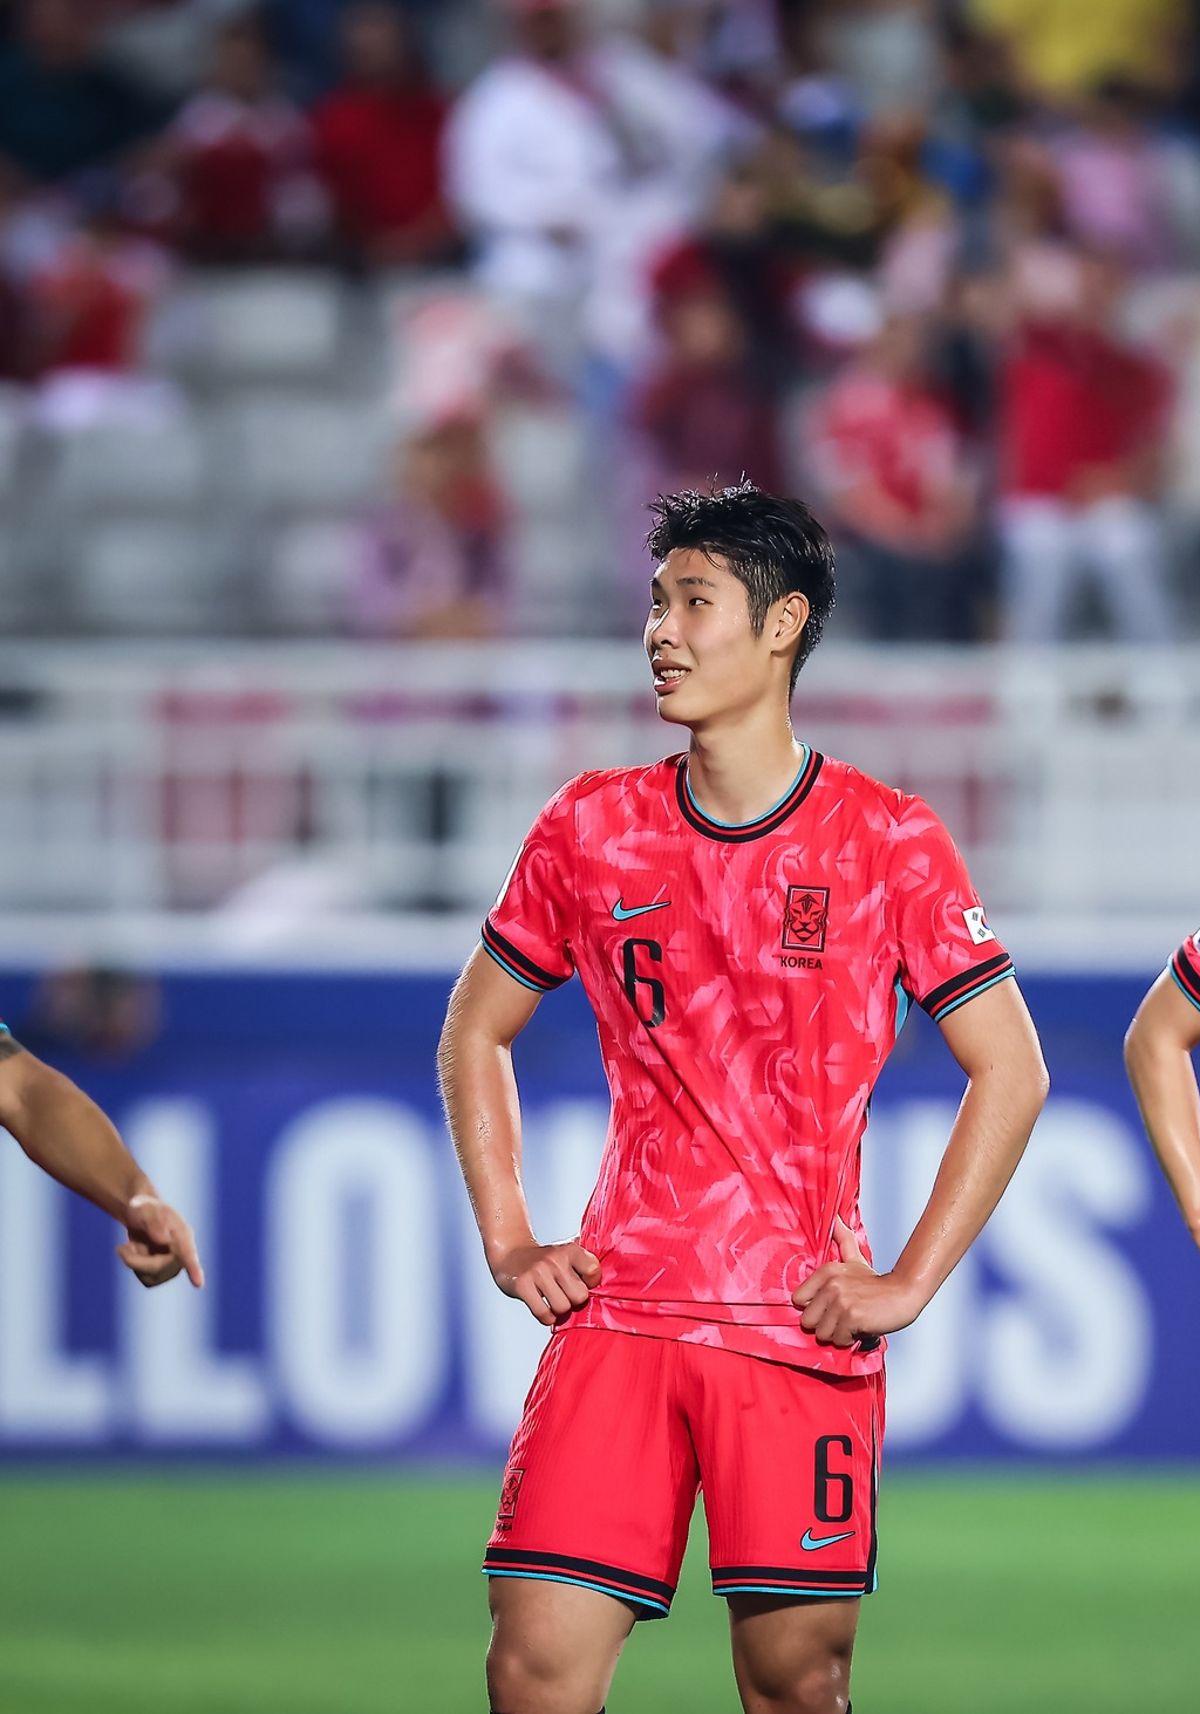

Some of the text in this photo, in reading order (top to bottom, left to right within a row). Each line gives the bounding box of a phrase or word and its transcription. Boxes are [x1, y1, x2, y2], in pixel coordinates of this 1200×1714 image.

[622, 937, 666, 1028] 6
[780, 955, 823, 970] KOREA
[814, 1434, 853, 1523] 6
